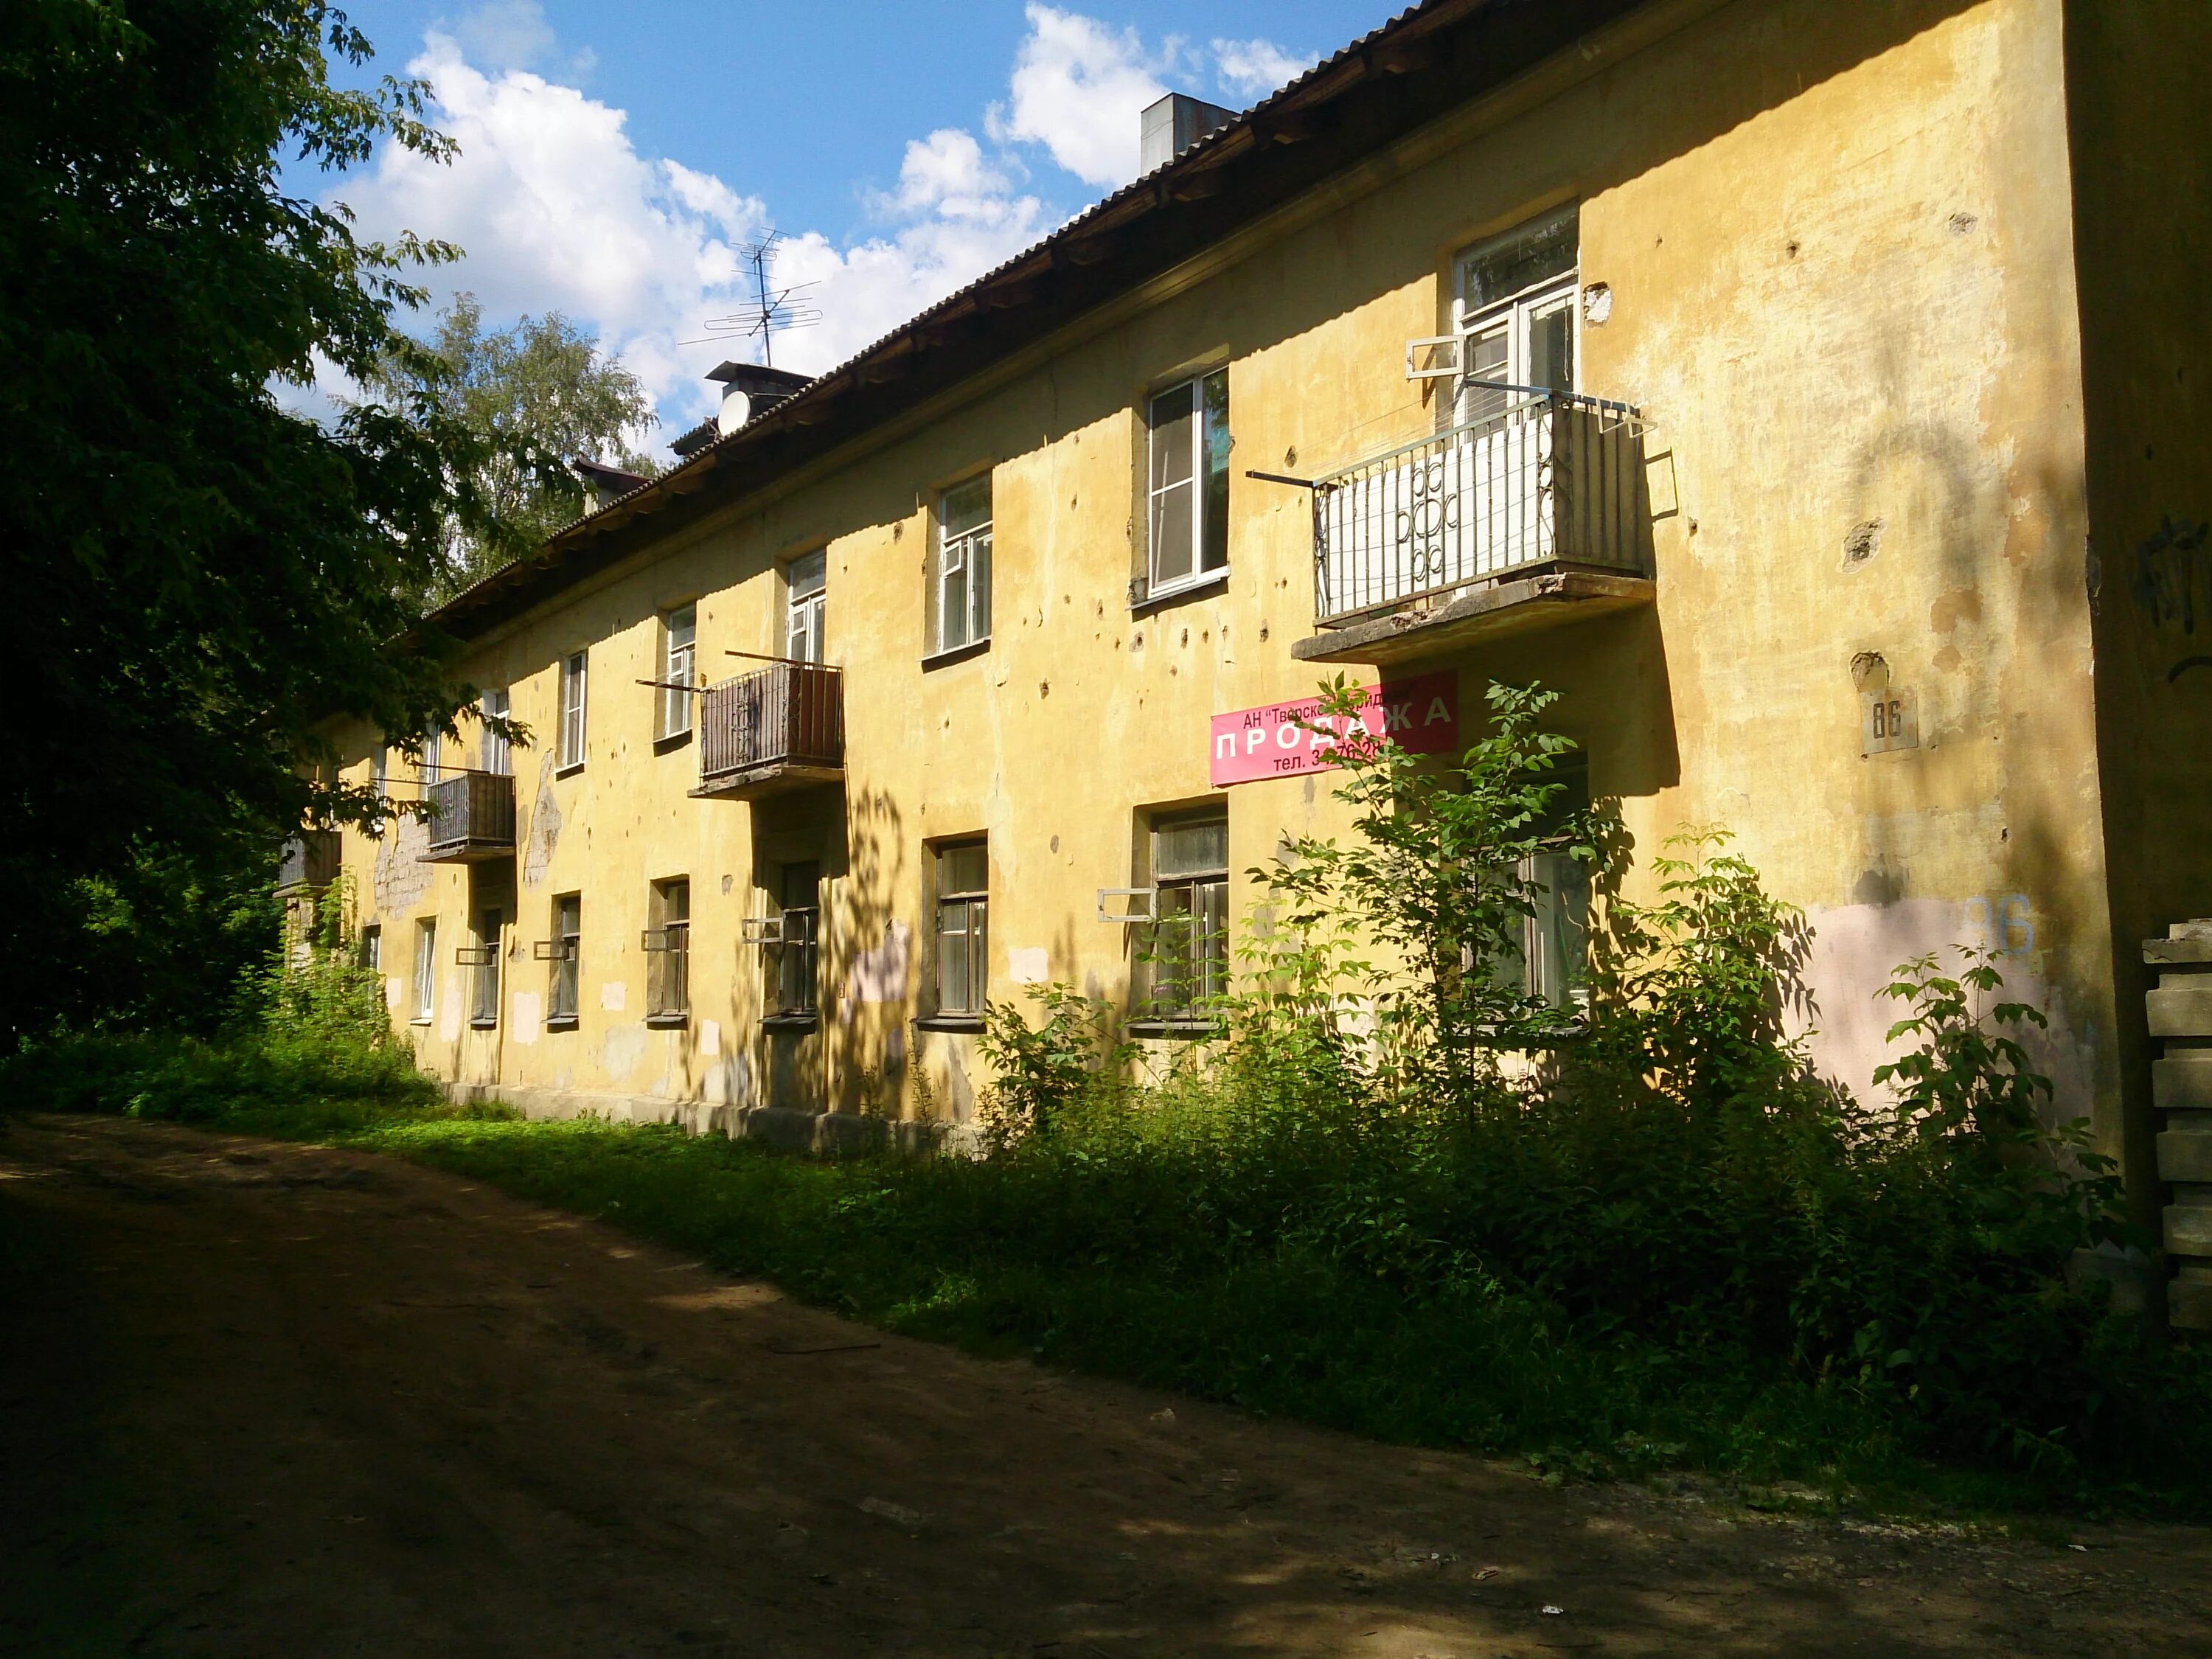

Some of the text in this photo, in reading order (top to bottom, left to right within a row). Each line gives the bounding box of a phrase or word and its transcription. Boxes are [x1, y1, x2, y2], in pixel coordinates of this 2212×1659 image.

[1216, 696, 1452, 759] ПРОДАЖА
[1243, 703, 1327, 729] АН “Тверско
[1873, 700, 1902, 739] 86
[1273, 755, 1306, 772] тел.
